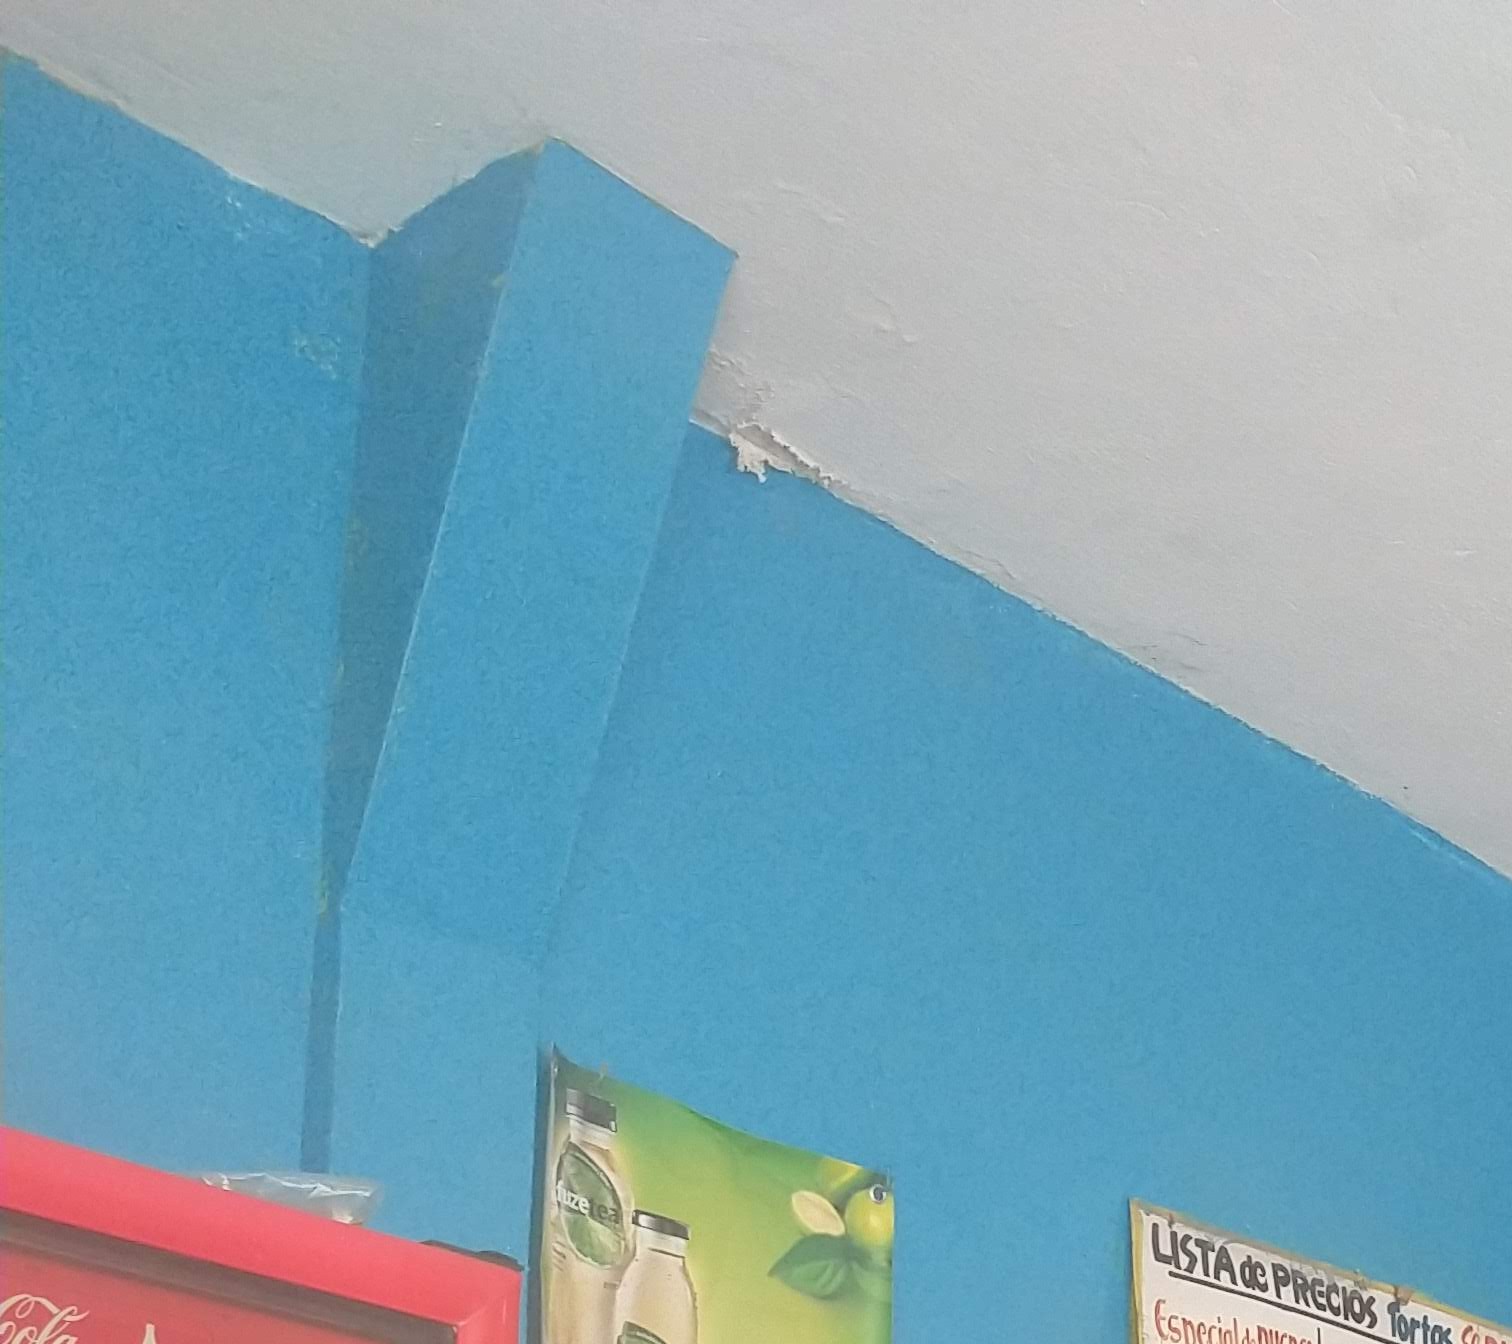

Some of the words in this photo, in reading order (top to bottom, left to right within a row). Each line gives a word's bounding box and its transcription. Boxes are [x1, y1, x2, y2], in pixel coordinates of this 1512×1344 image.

[1152, 1222, 1237, 1285] LISTA
[1240, 1255, 1269, 1293] de
[1271, 1262, 1378, 1329] PRECIOS
